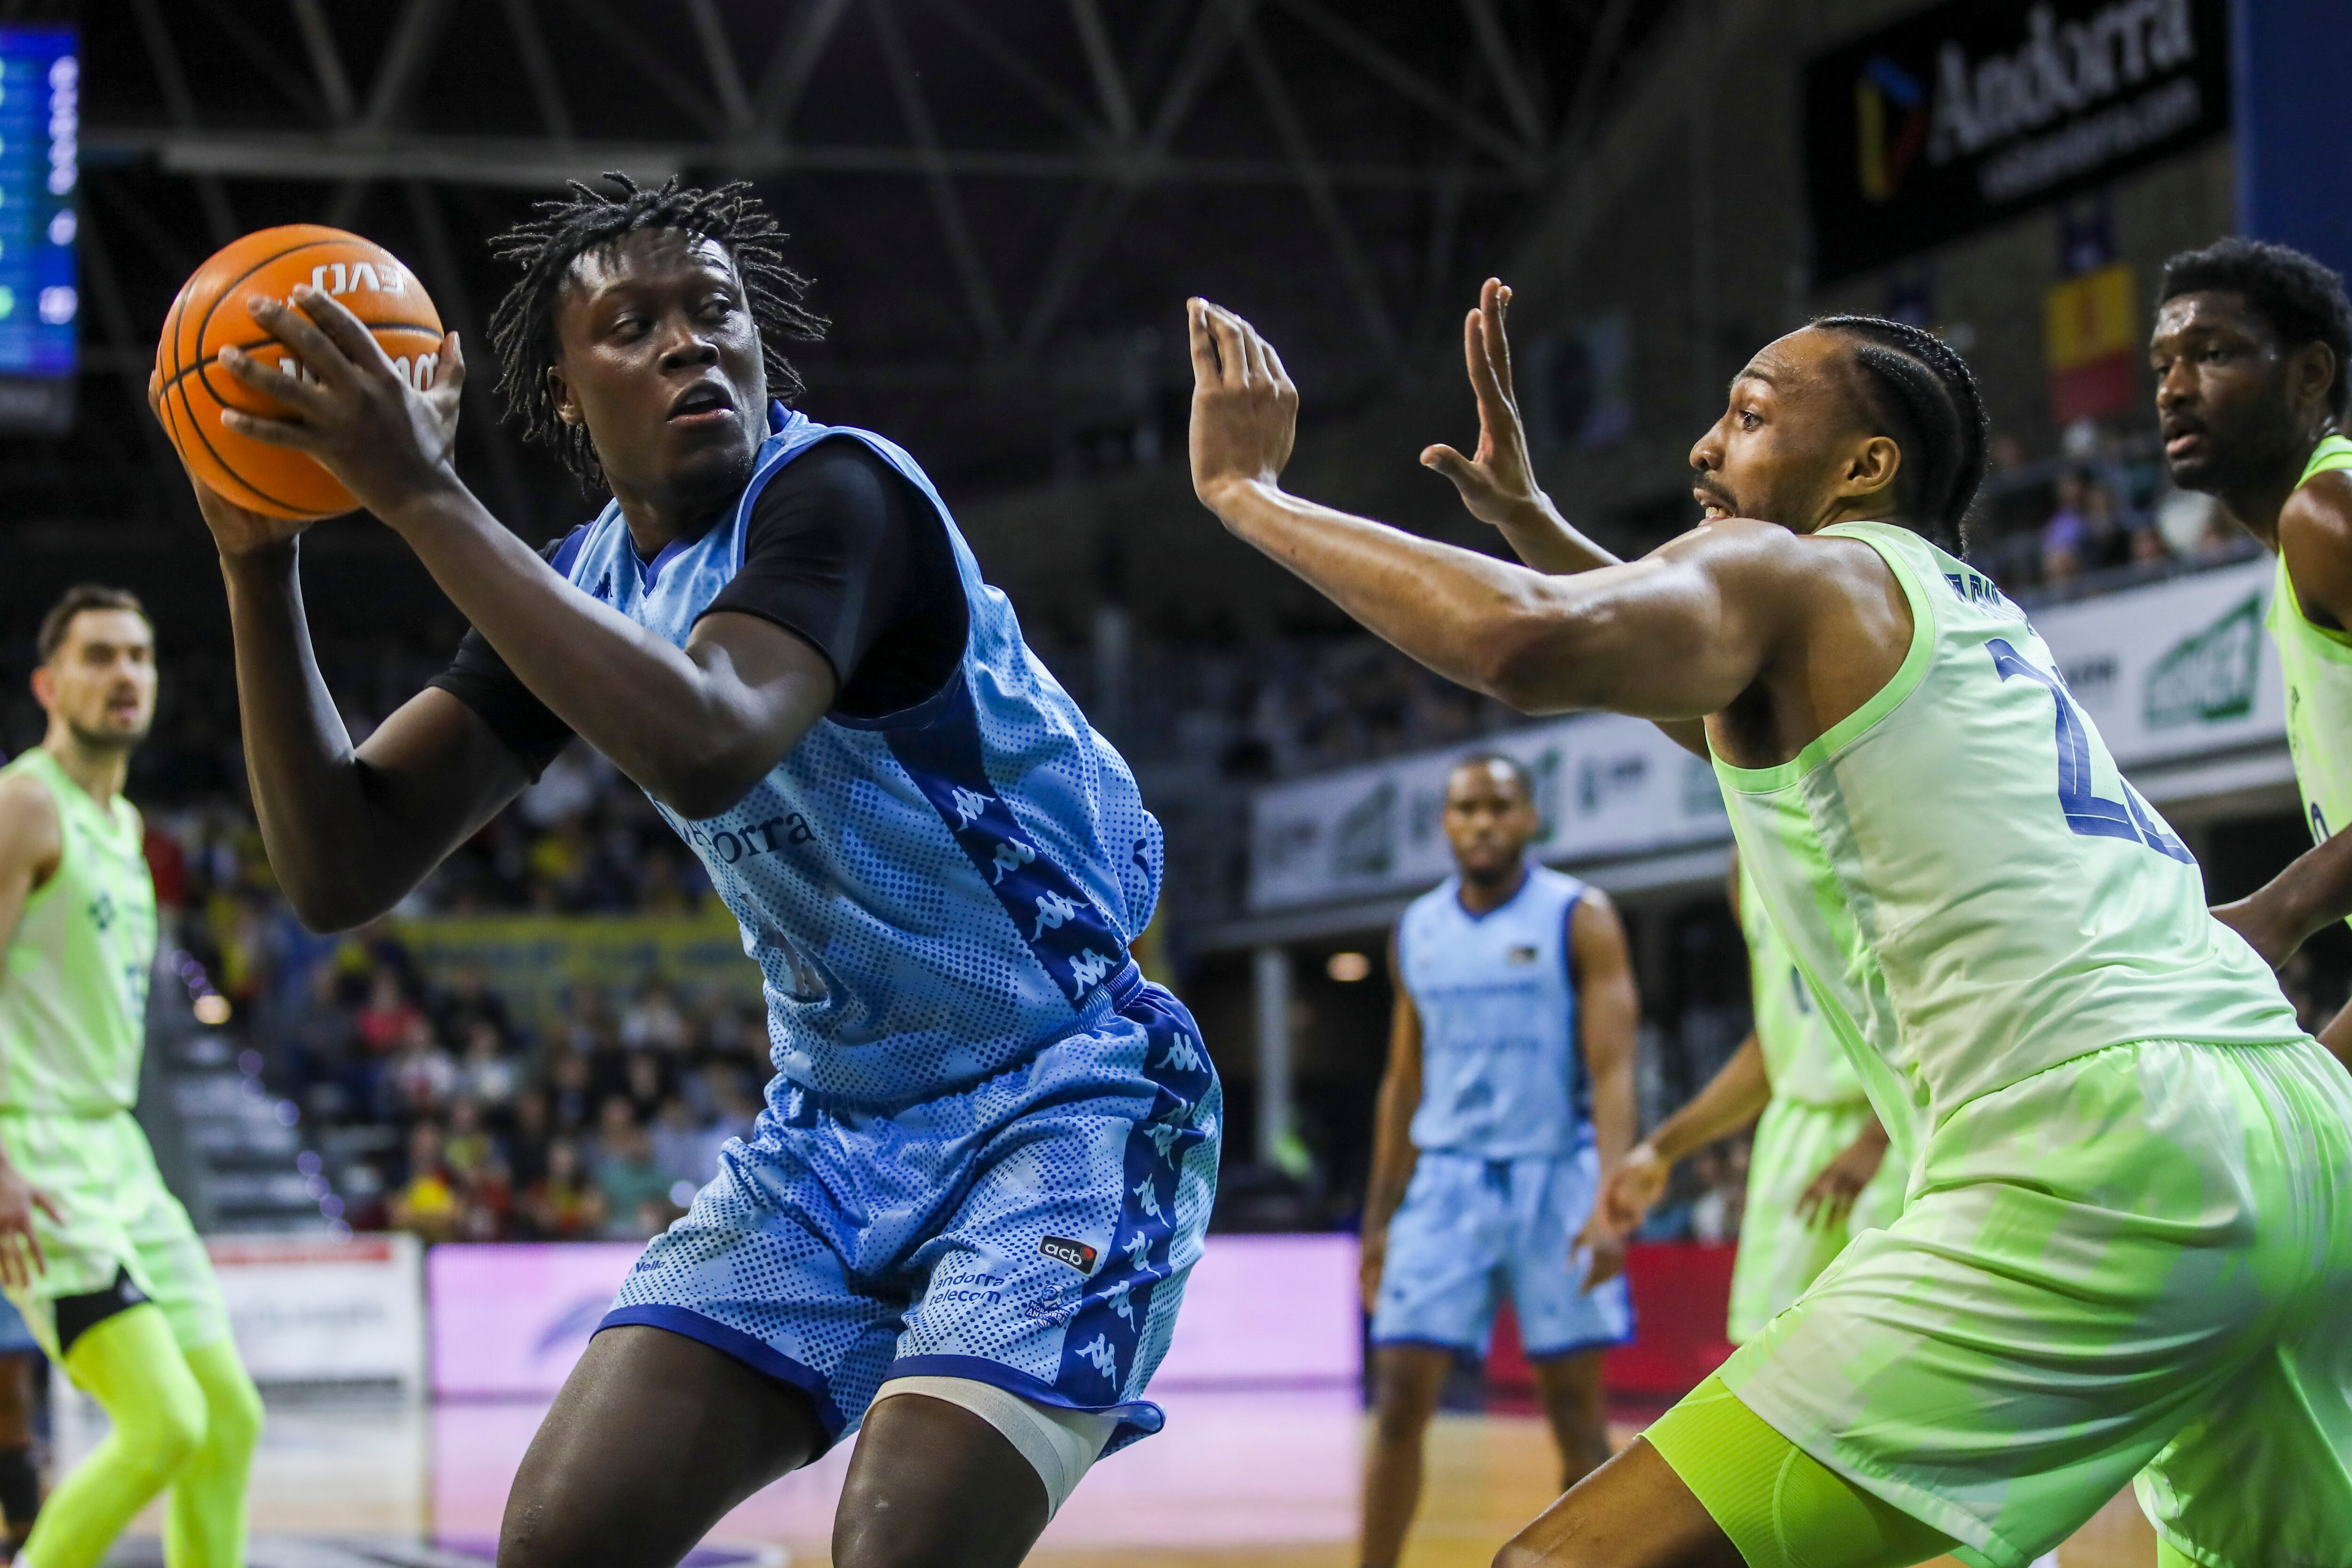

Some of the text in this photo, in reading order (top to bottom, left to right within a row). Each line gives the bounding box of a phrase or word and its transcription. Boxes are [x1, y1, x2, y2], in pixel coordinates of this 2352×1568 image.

[312, 261, 406, 295] EVO
[1044, 1243, 1082, 1266] acb
[935, 1272, 1005, 1291] andorra
[929, 1289, 1001, 1306] telecom
